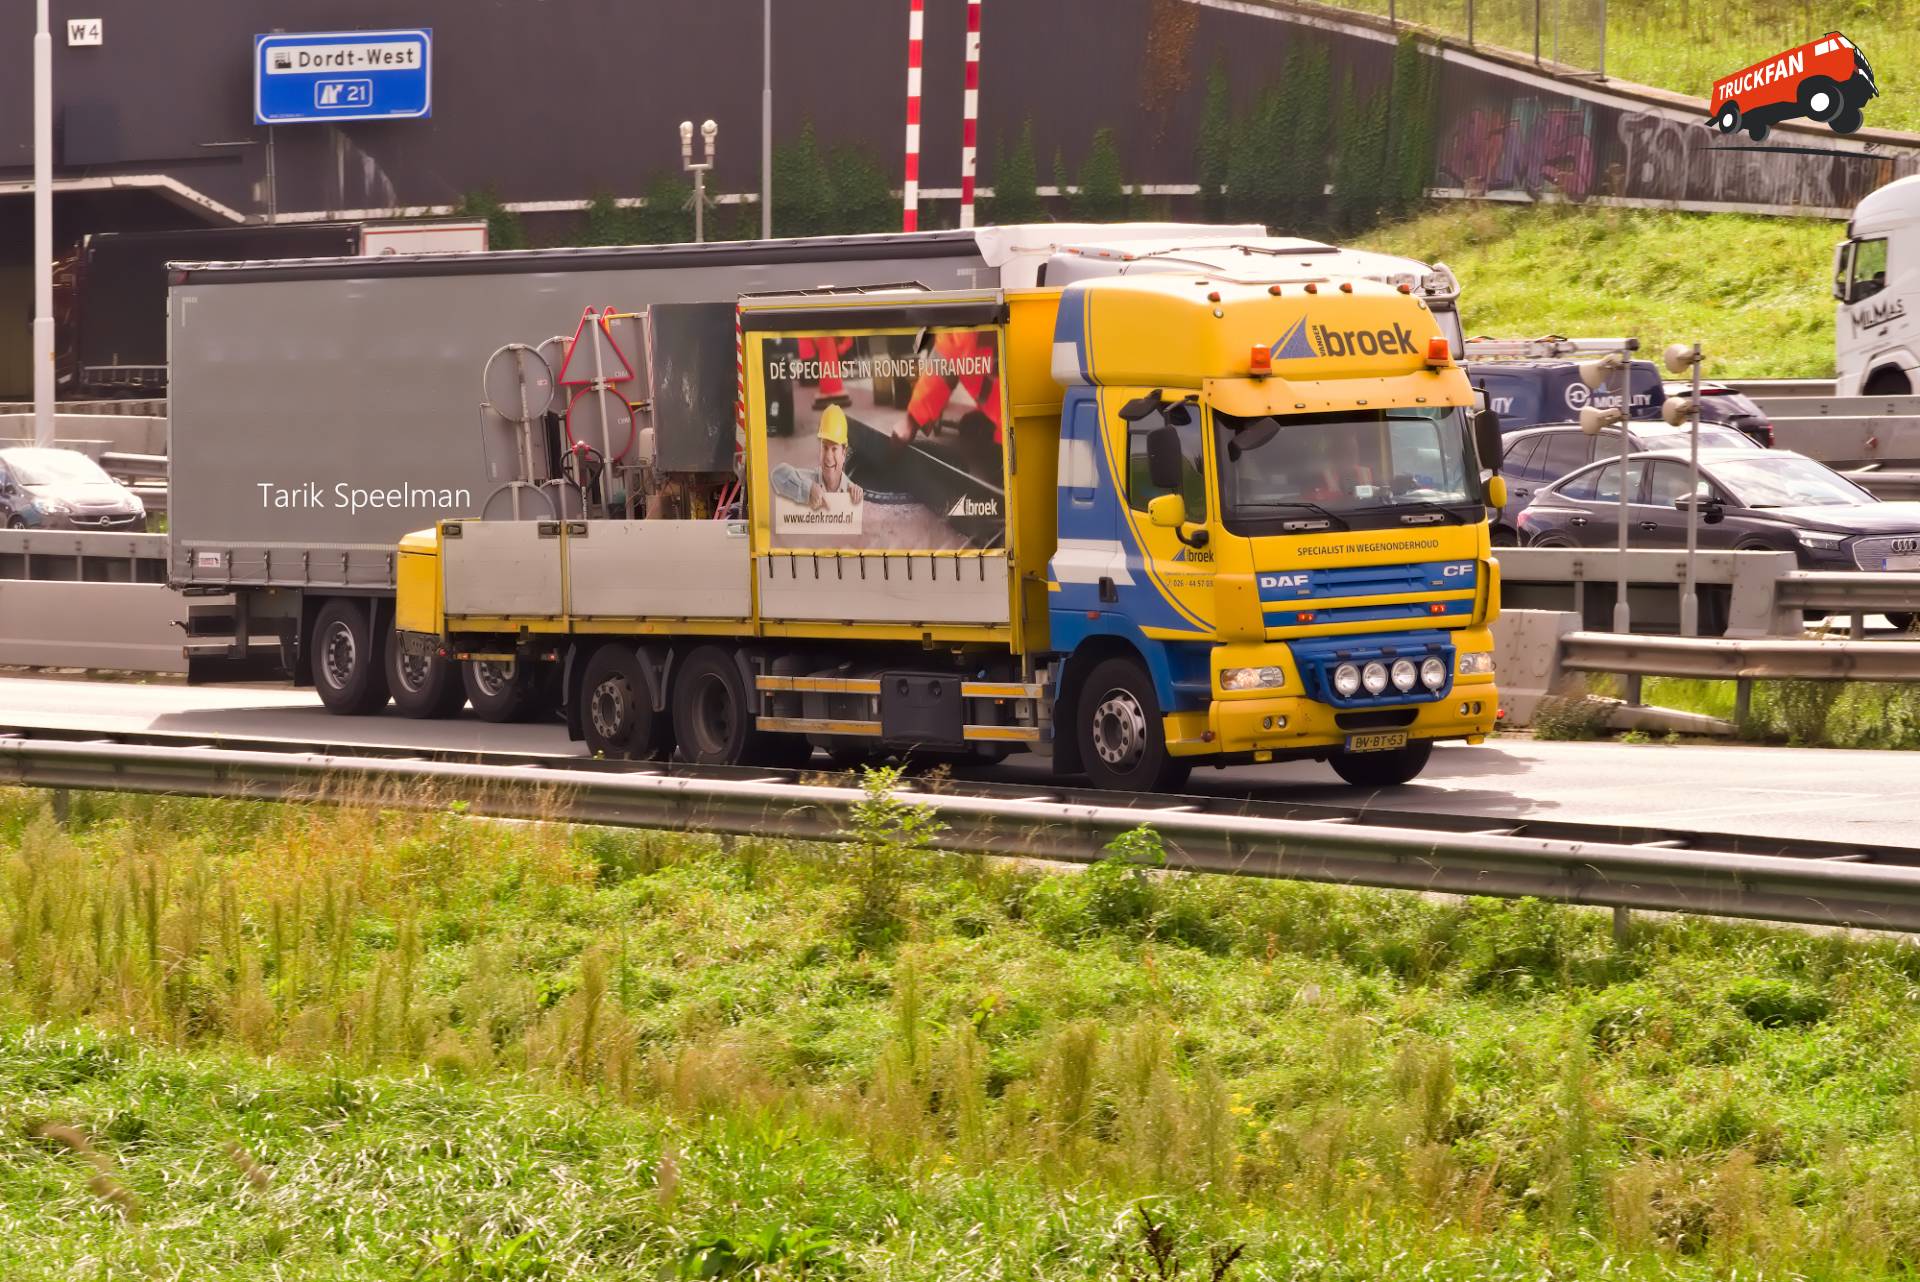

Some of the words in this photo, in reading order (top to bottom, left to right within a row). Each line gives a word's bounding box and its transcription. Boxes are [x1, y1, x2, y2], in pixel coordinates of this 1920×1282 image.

[299, 48, 414, 67] Dordt-West
[347, 86, 366, 101] 21
[1319, 322, 1419, 357] broek
[770, 358, 786, 380] DÉ
[789, 360, 855, 380] SPECIALIST
[859, 360, 871, 378] IN
[874, 359, 916, 378] RONDE
[918, 355, 991, 377] PUTRANDEN
[969, 498, 998, 516] broek
[783, 511, 853, 525] www.denkrond.nl
[1188, 549, 1215, 563] broek
[1297, 545, 1344, 557] SPECIALIST
[1346, 544, 1355, 553] IN
[1356, 539, 1439, 553] WEGENONDERHOUD
[1443, 564, 1473, 577] CF
[1261, 574, 1309, 588] DAF
